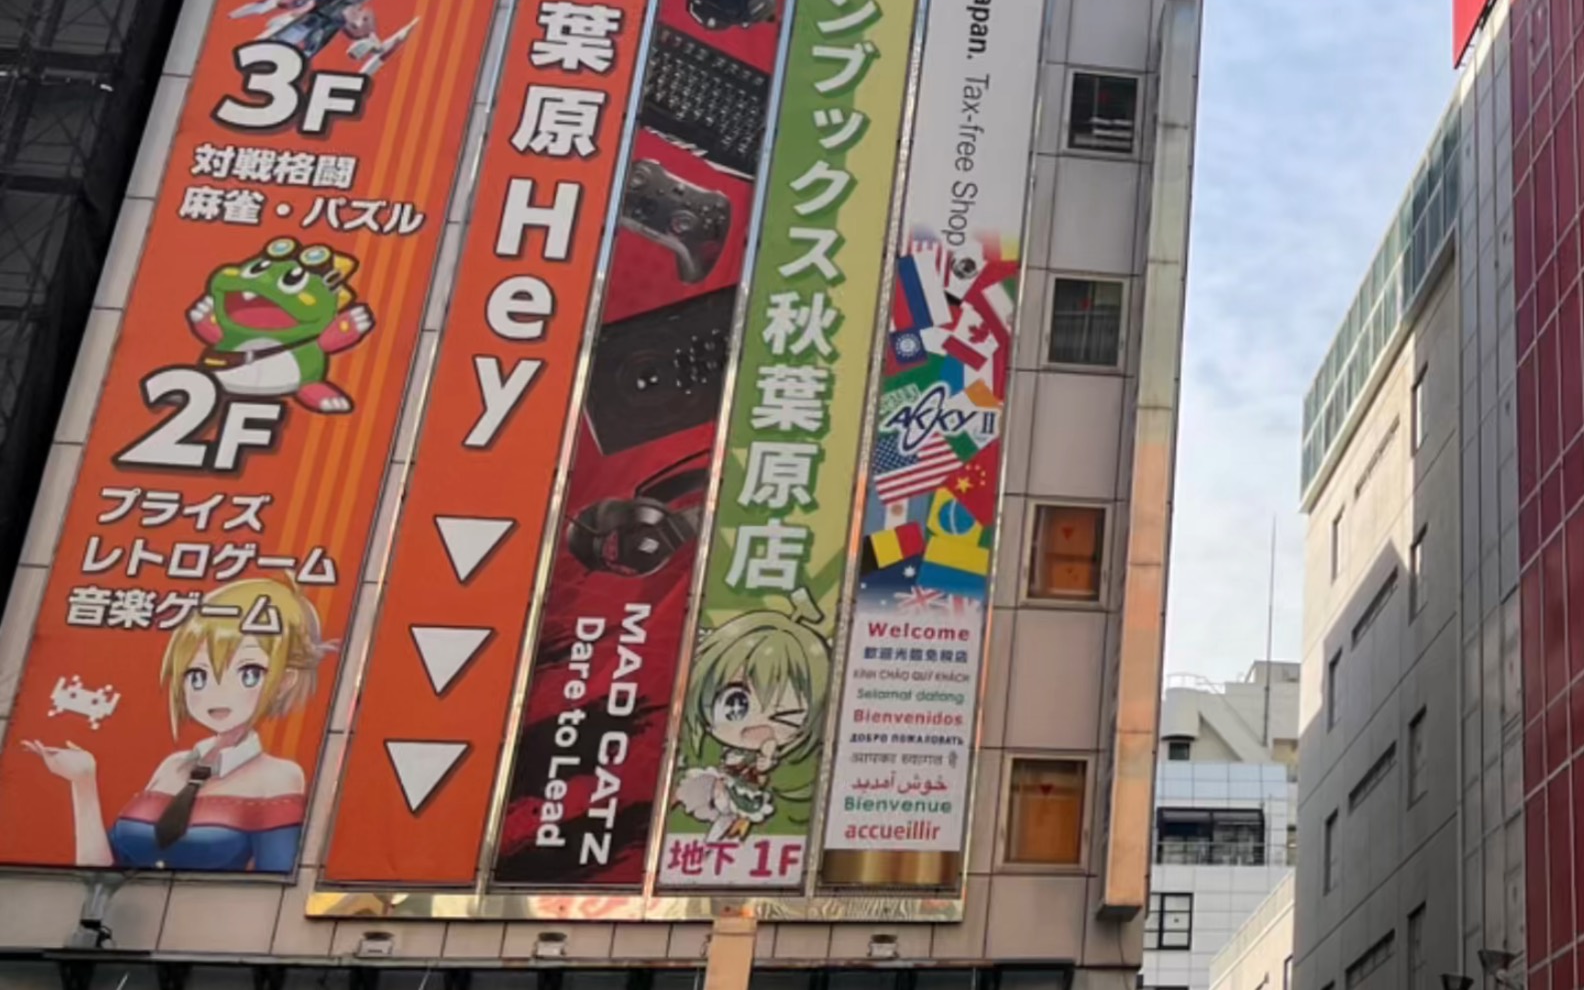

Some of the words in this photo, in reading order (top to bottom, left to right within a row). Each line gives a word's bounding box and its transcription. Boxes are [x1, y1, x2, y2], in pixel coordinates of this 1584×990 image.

[212, 42, 367, 134] 3F
[953, 72, 990, 173] Tax-free
[191, 143, 359, 190] 対戦格闘
[948, 180, 978, 248] Shop
[113, 368, 283, 473] 2F
[98, 486, 271, 532] プライズ
[81, 536, 338, 585] レトロゲーム
[66, 585, 284, 635] 音楽ゲーム
[868, 622, 970, 642] Welcome
[563, 616, 605, 701] Dare
[607, 602, 651, 717] MAD
[854, 709, 963, 726] Bienvenidos
[857, 688, 912, 701] Selamat
[916, 690, 965, 705] datang
[554, 709, 586, 748] to
[535, 754, 580, 848] Lead
[580, 730, 627, 866] CATZ
[844, 796, 952, 813] Bienvenue
[844, 821, 941, 840] accueillir
[667, 839, 737, 875] 地下
[750, 842, 802, 877] 1F
